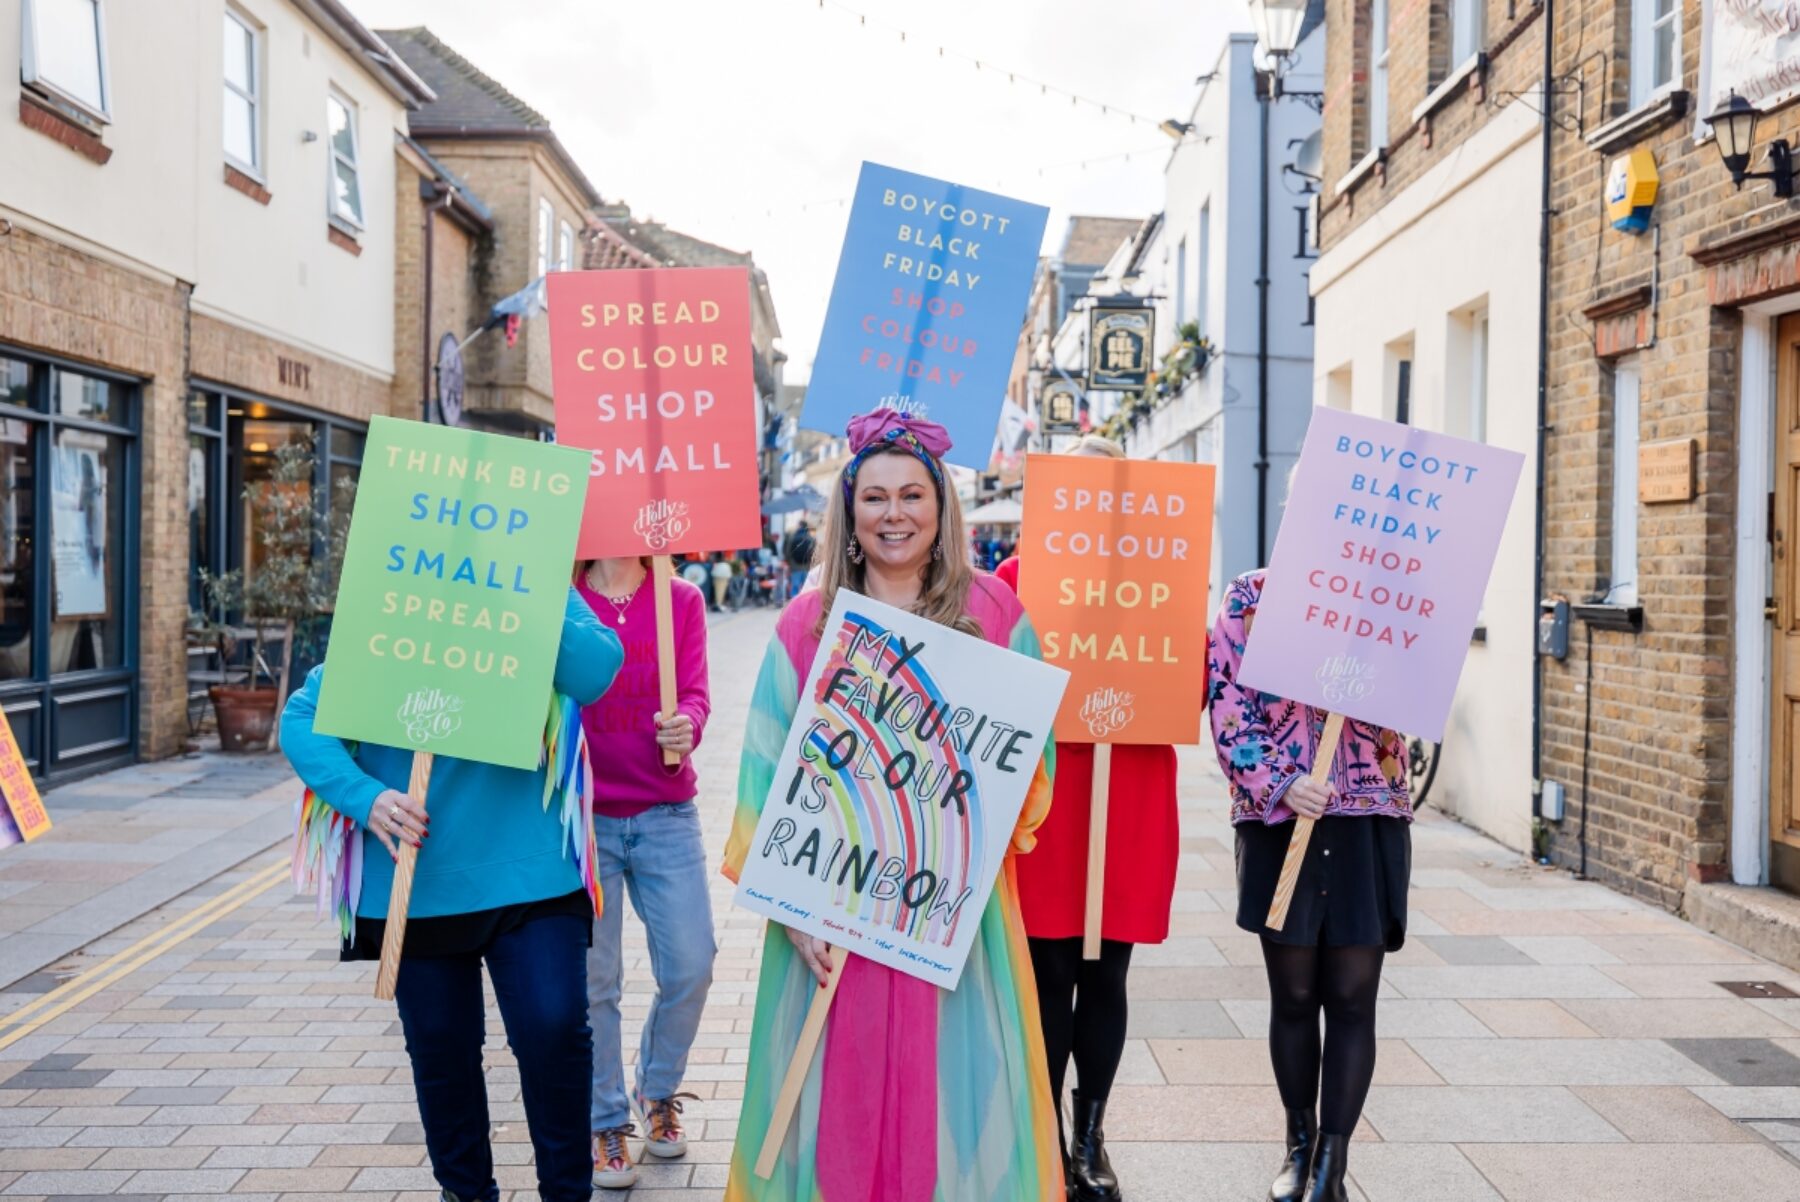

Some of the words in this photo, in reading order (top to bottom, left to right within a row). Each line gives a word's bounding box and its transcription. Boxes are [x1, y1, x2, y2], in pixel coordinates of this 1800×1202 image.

[883, 189, 1010, 235] BOYCOTT
[898, 224, 981, 259] BLACK
[883, 253, 981, 290] FRIDAY
[580, 301, 720, 327] SPREAD
[891, 287, 965, 319] SHOP
[862, 315, 978, 358] COLOUR
[577, 343, 728, 372] COLOUR
[860, 348, 964, 388] FRIDAY
[597, 390, 714, 422] SHOP
[386, 446, 494, 483] THINK
[508, 465, 572, 495] BIG
[590, 443, 731, 476] SMALL
[1336, 435, 1478, 484] BOYCOTT
[1054, 488, 1186, 517] SPREAD
[1351, 474, 1443, 511] BLACK
[410, 493, 529, 535] SHOP
[634, 499, 678, 532] Holly
[1334, 504, 1441, 545] FRIDAY
[1044, 531, 1189, 560] COLOUR
[1341, 541, 1422, 576] SHOP
[387, 545, 530, 594] SMALL
[1058, 577, 1171, 609] SHOP
[1308, 570, 1435, 619] COLOUR
[382, 591, 521, 634] SPREAD
[1305, 604, 1419, 650] FRIDAY
[368, 633, 520, 679] COLOUR
[845, 623, 925, 679] MY
[1043, 631, 1179, 664] SMALL
[1315, 653, 1367, 680] Holly
[398, 687, 450, 720] Holly
[823, 668, 1033, 774] FAVOURITE
[1080, 687, 1122, 718] Holly
[799, 718, 973, 816] COLOUR
[785, 765, 832, 814] IS
[762, 817, 973, 927] RAINBOW
